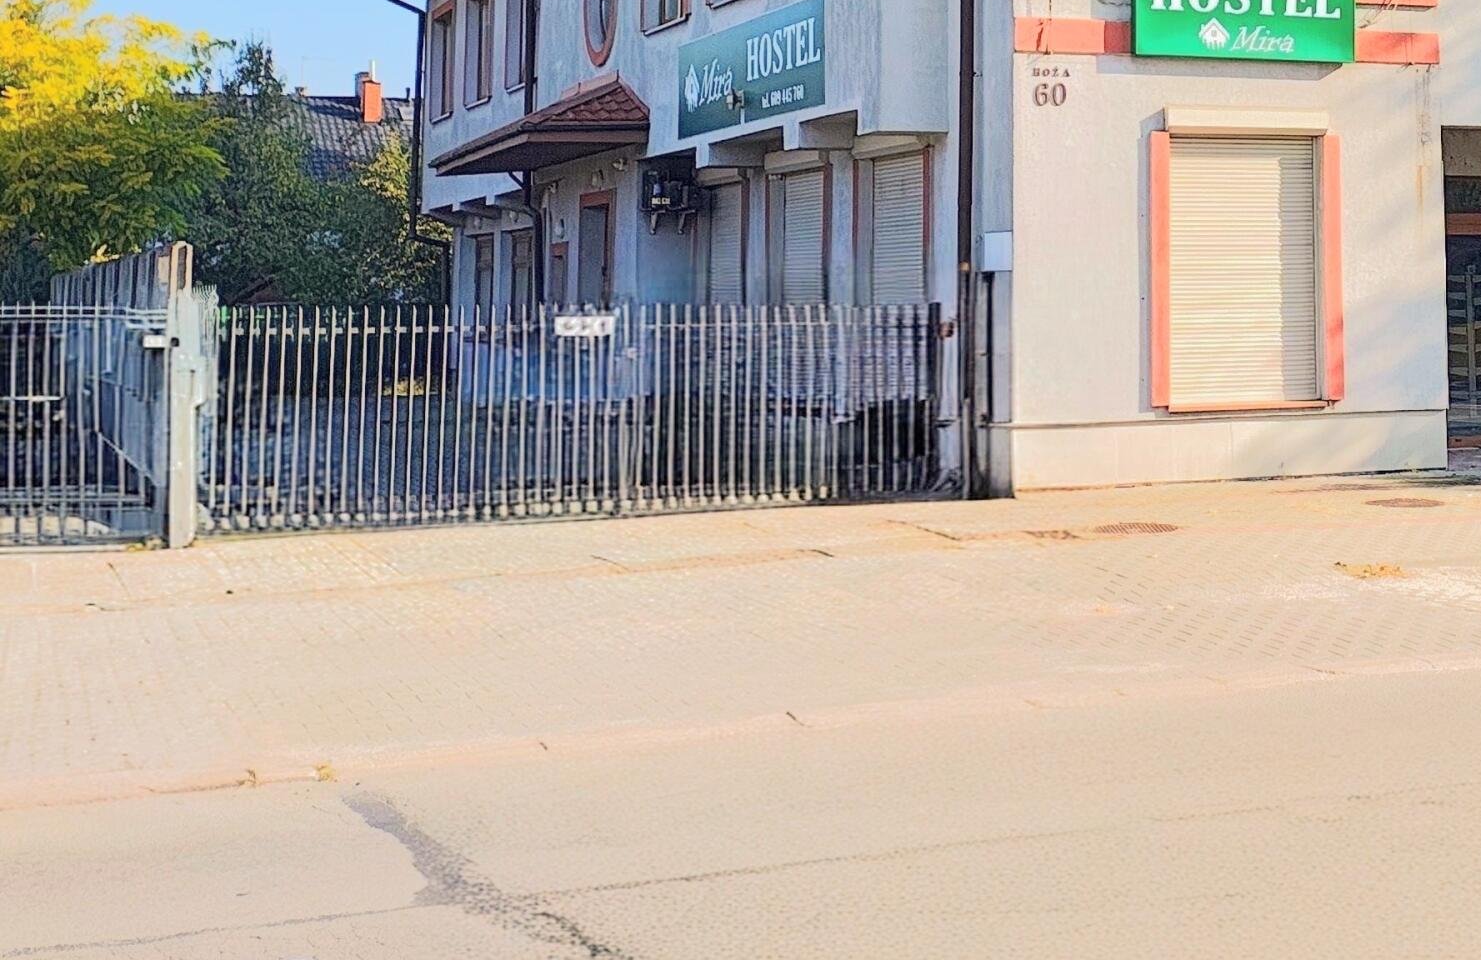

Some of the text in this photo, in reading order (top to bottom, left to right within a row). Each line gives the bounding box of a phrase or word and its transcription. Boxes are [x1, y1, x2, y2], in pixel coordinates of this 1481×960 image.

[746, 17, 821, 82] HOSTEL
[1229, 25, 1295, 53] Mira
[698, 58, 733, 106] Mira
[1033, 83, 1067, 107] 60
